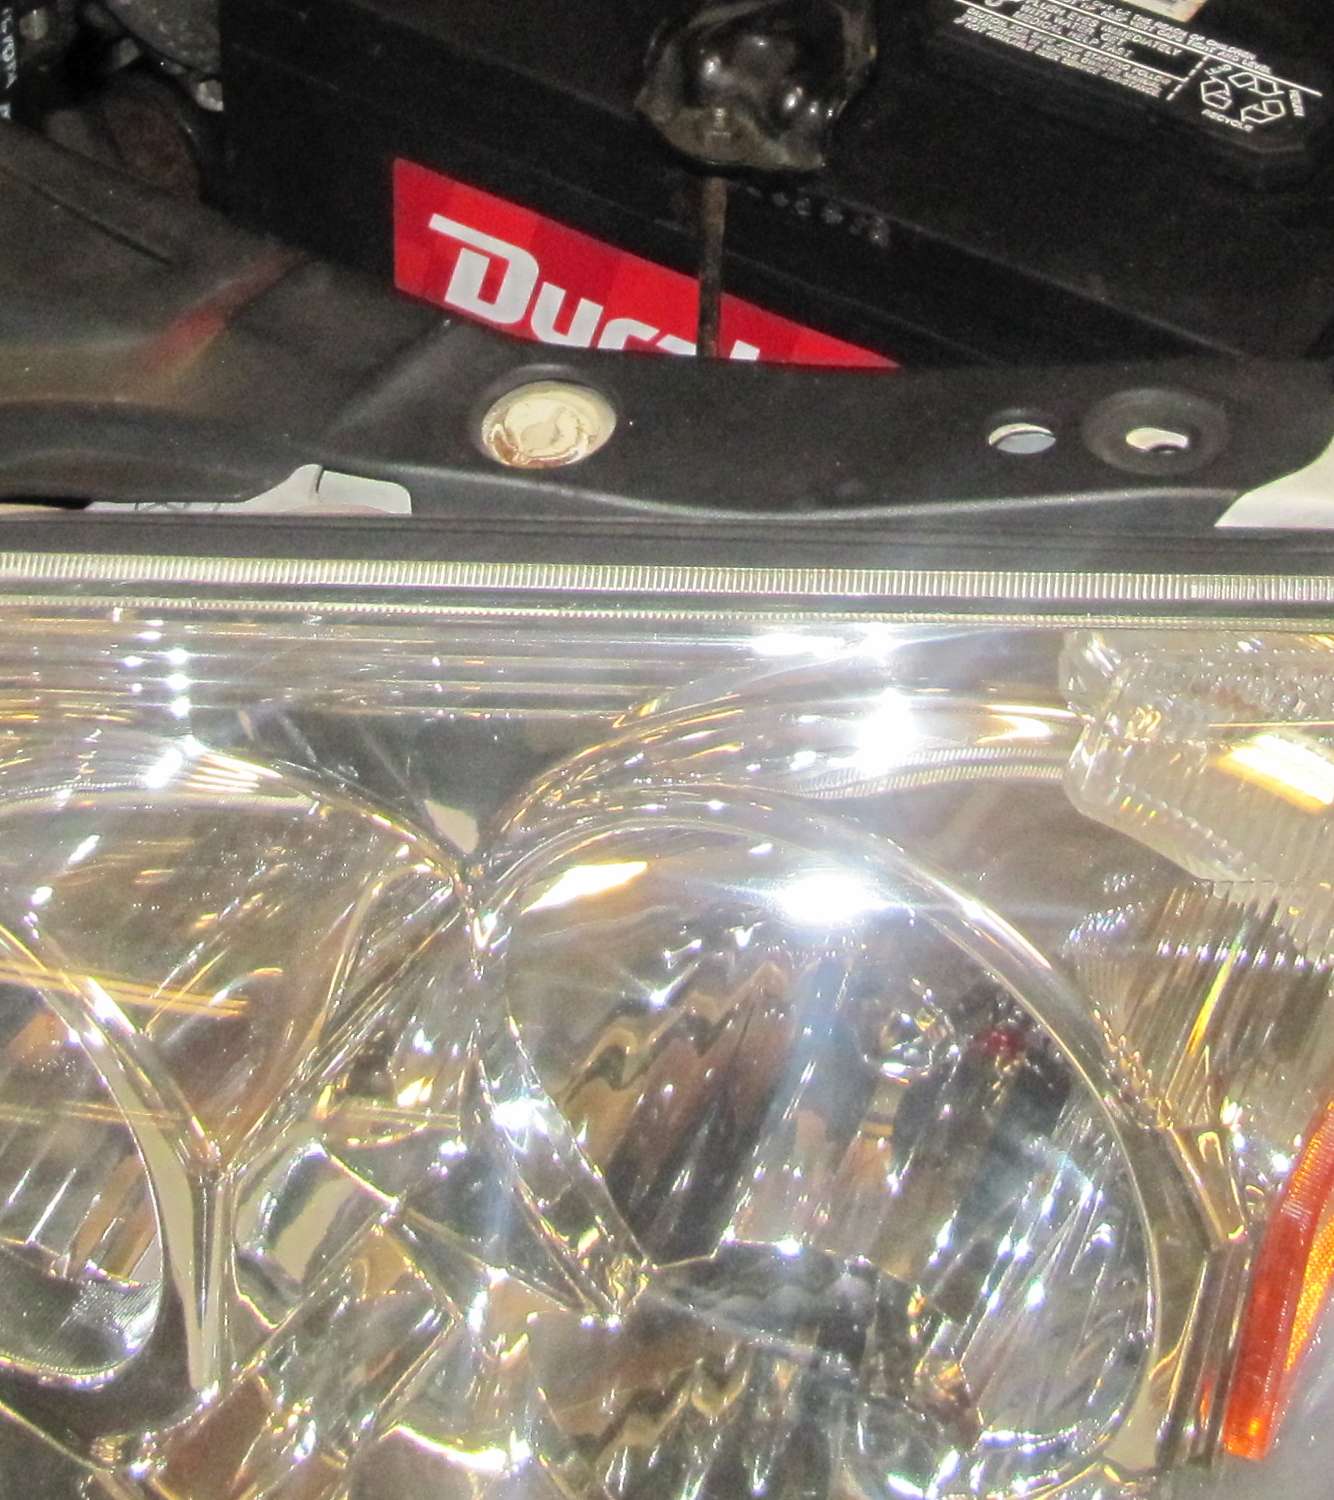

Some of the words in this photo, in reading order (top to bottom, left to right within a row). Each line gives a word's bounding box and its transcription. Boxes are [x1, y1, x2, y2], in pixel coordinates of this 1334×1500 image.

[1010, 12, 1067, 34] MEDICAL
[1066, 31, 1101, 46] HELP
[1100, 43, 1134, 57] FAST
[1018, 5, 1051, 19] WITH
[1098, 33, 1127, 45] GET
[1066, 12, 1100, 26] EYES
[1099, 24, 1182, 55] IMMEDIATELY
